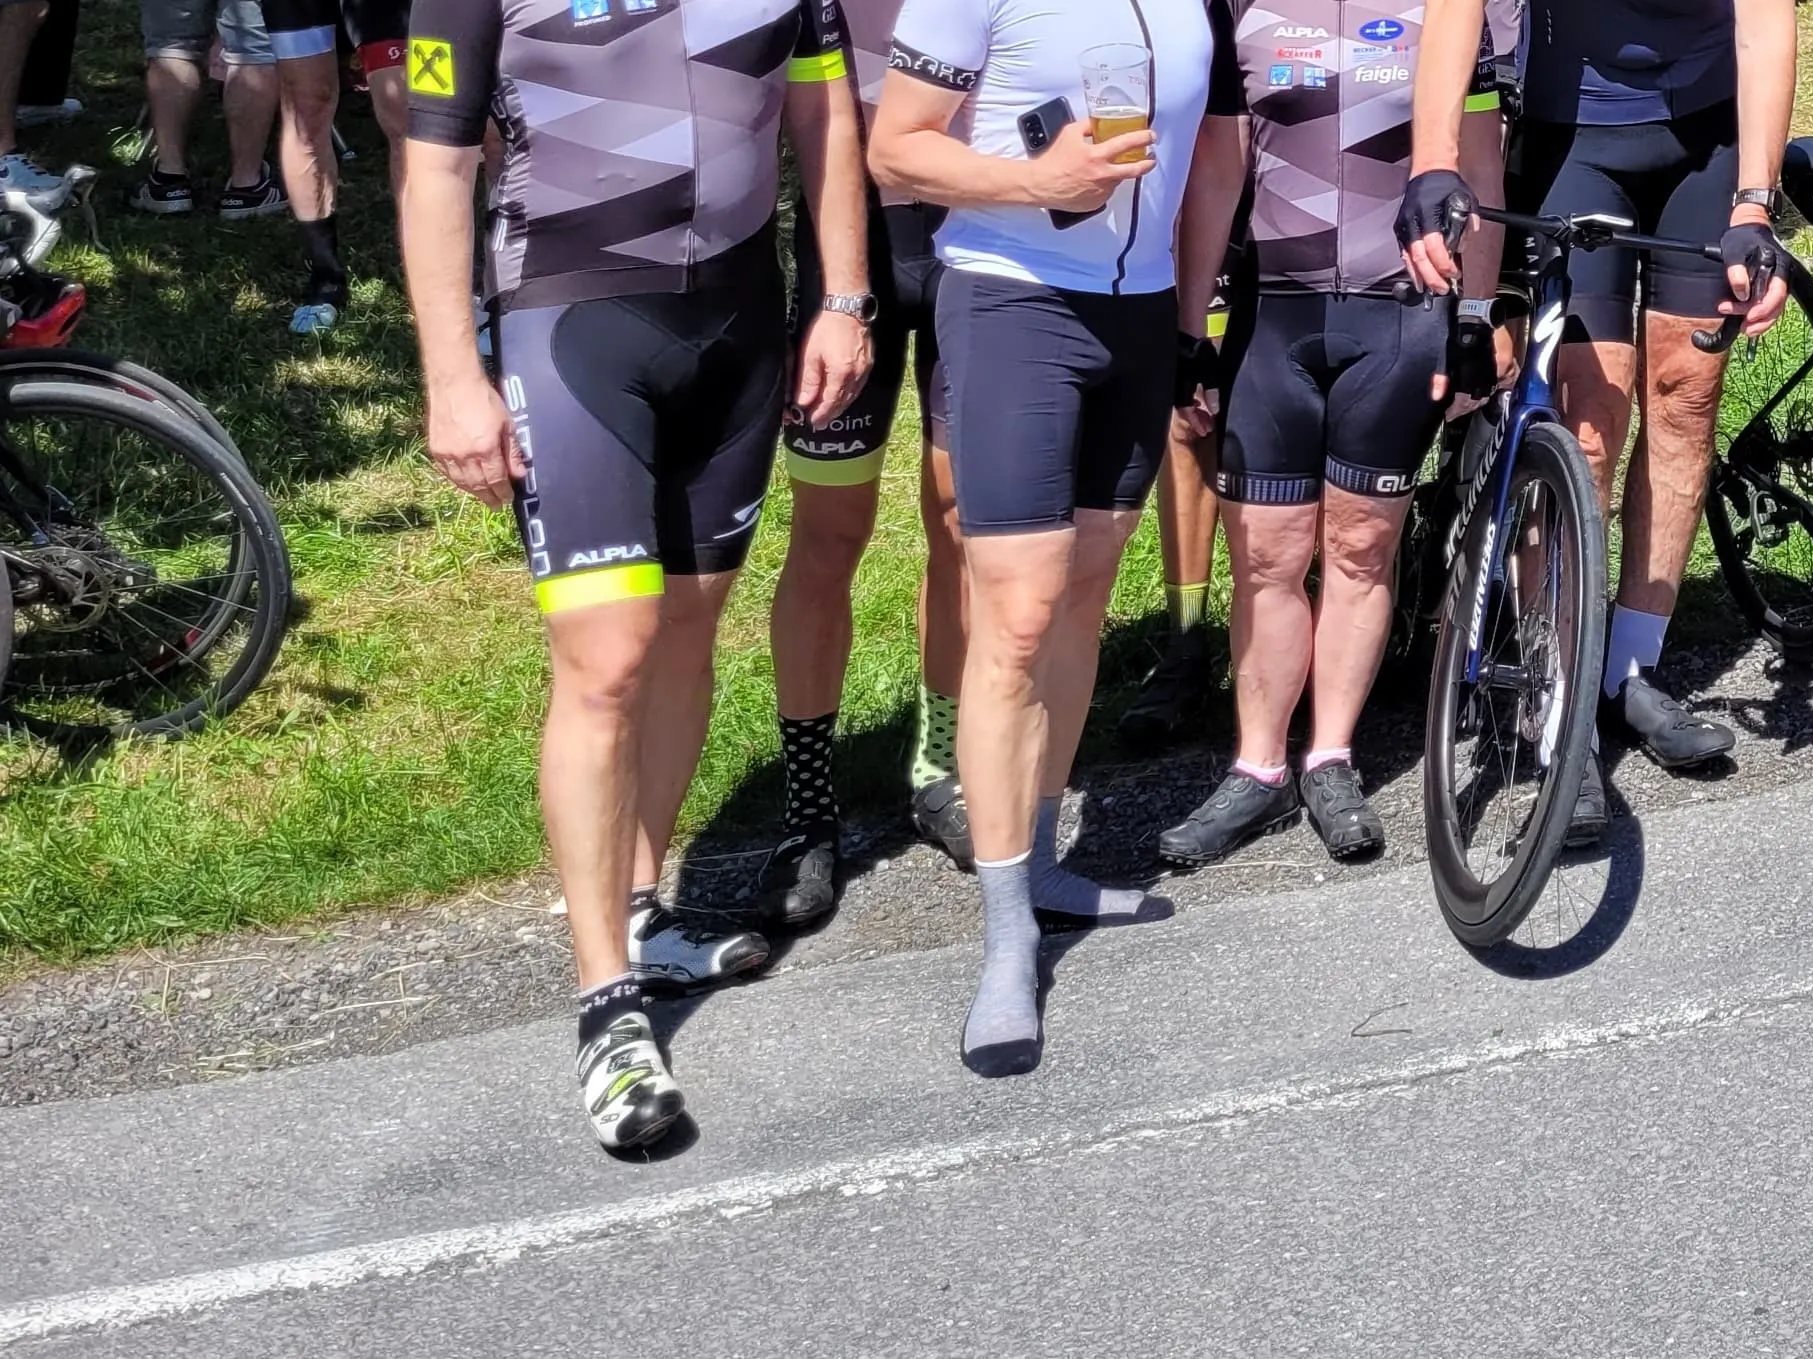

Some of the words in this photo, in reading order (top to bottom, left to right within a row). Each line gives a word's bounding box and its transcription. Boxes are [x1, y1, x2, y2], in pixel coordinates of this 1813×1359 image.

[1273, 26, 1329, 38] ALPLA
[1354, 65, 1409, 84] faigle
[792, 437, 867, 455] ALPLA
[568, 543, 649, 568] ALPLA
